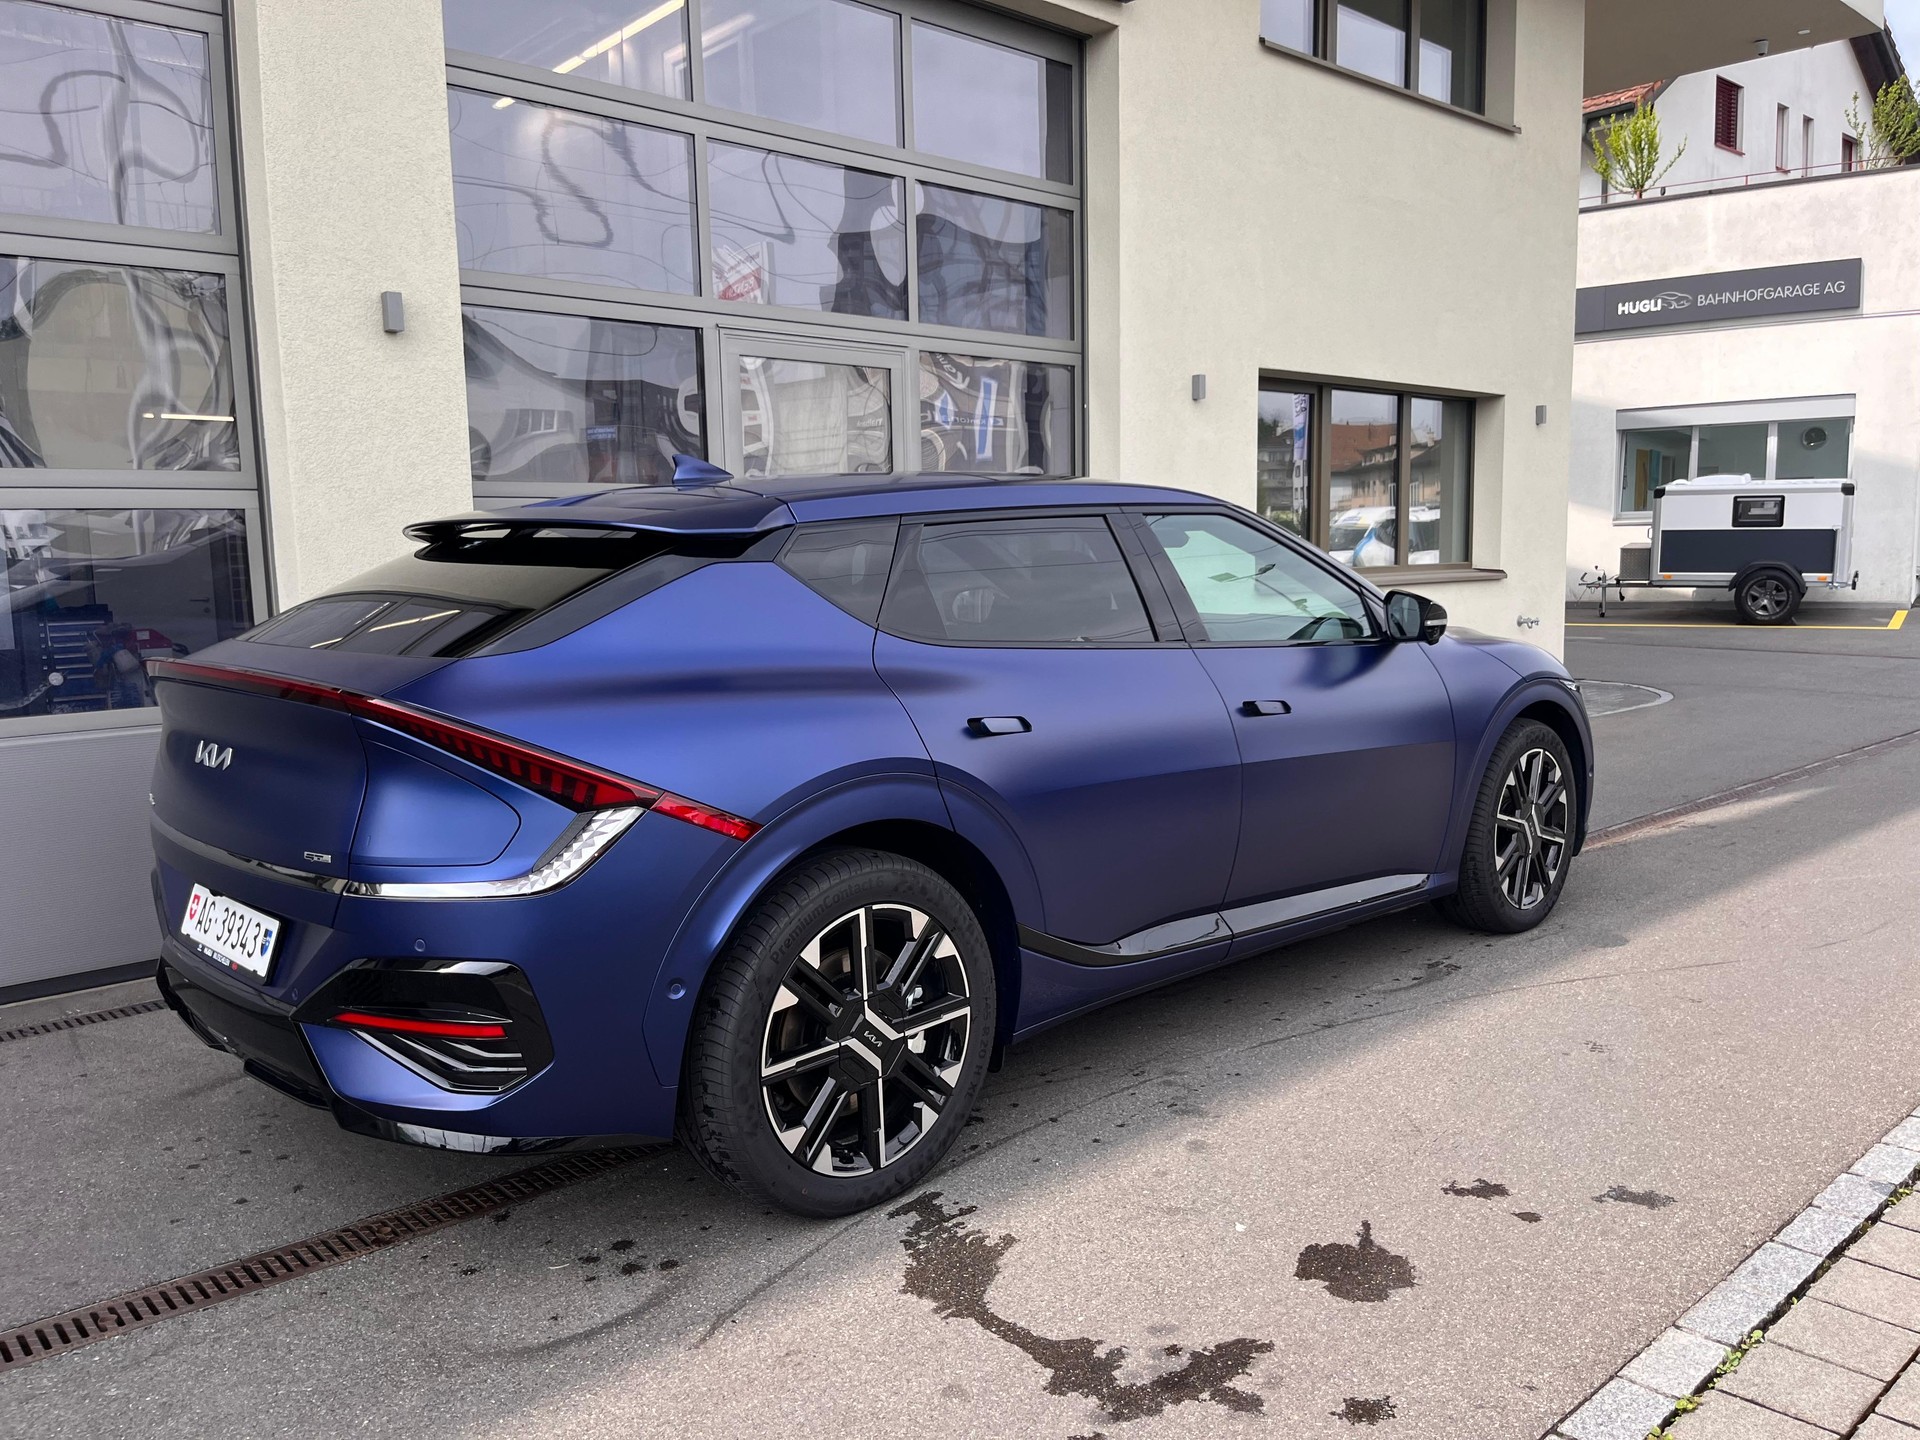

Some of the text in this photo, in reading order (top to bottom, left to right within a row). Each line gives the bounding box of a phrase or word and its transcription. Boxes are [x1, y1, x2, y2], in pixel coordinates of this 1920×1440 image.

[1617, 281, 1846, 315] HUGLI BAHNHOFGARAGE AG
[195, 740, 232, 771] KIA
[771, 878, 872, 963] PremiumContact
[863, 1030, 883, 1048] KIA
